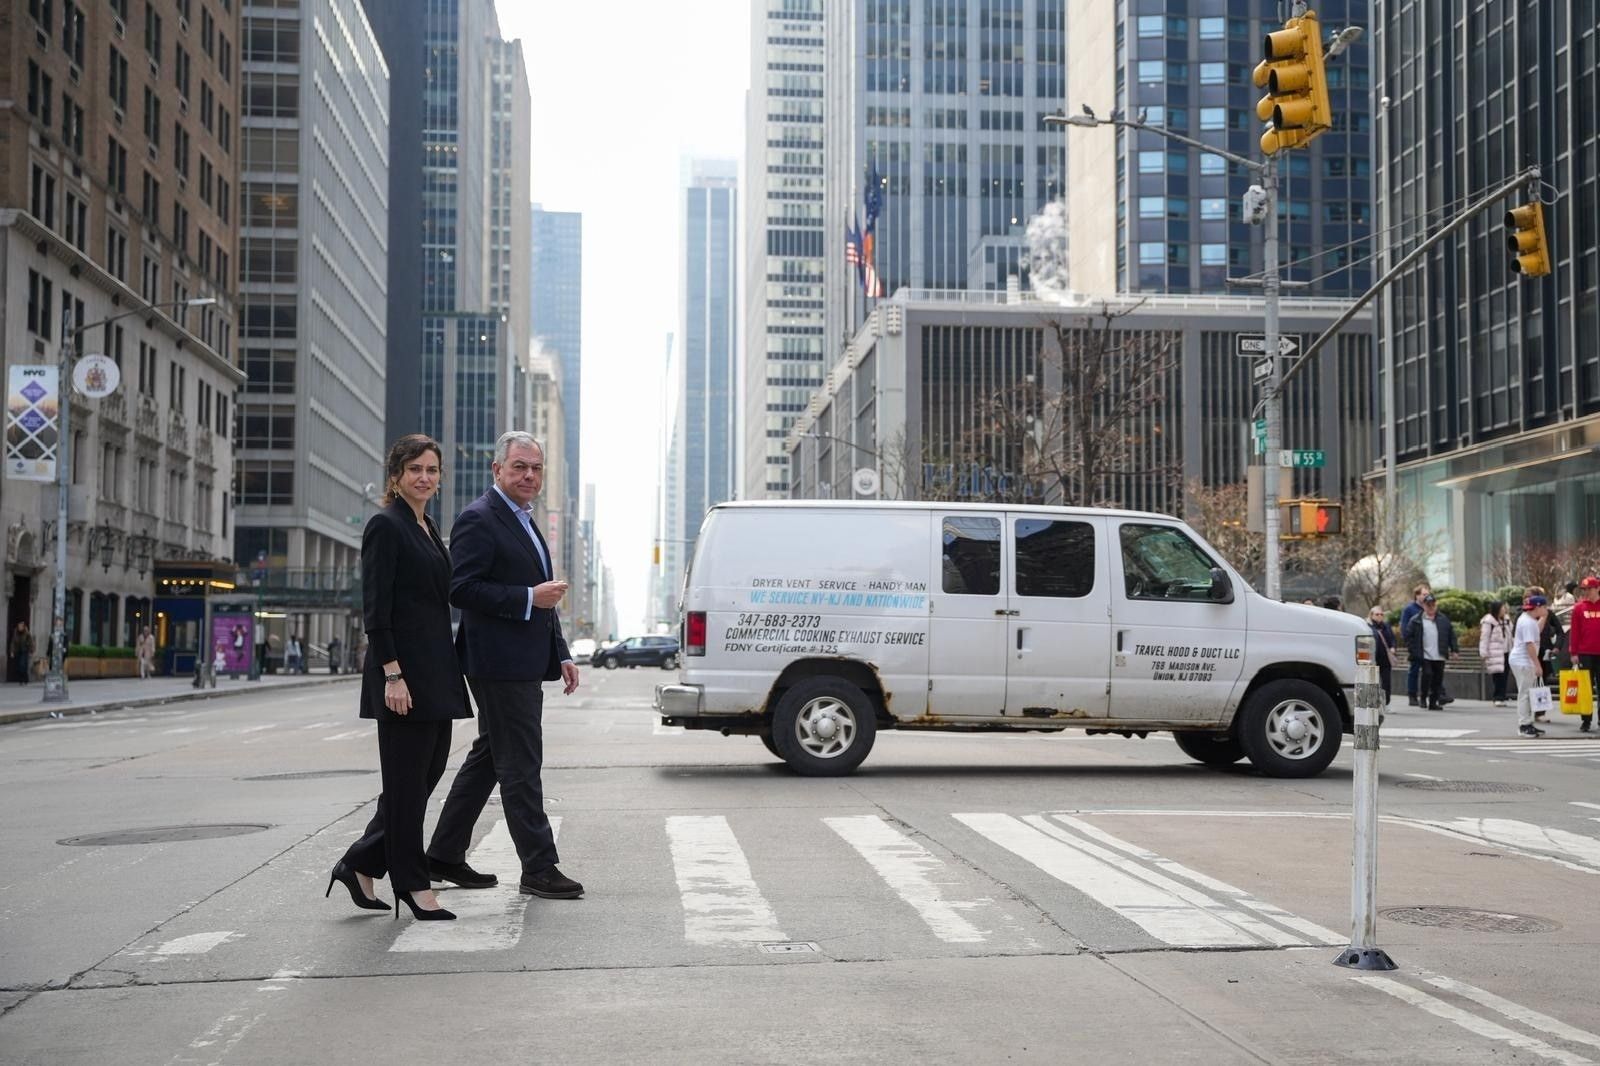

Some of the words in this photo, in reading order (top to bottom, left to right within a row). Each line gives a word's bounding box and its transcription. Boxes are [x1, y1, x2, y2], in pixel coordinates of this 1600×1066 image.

[1243, 341, 1262, 349] ONE
[1293, 452, 1301, 465] W
[1303, 452, 1315, 465] 55
[752, 578, 783, 588] DRYER
[786, 579, 811, 588] VENT
[818, 580, 857, 590] SERVICE
[868, 581, 902, 591] HANDY
[904, 582, 927, 591] MAN
[751, 590, 765, 603] WE
[768, 591, 808, 605] SERVICE
[811, 592, 841, 606] NY-NJ
[842, 593, 863, 606] AND
[865, 594, 925, 609] NATIONWIDE
[737, 613, 821, 628] 347-683-2373
[725, 627, 790, 641] COMMERCIAL
[793, 629, 836, 643] COOKING
[838, 630, 883, 644] EXHAUST
[884, 631, 926, 646] SERVICE
[724, 643, 753, 652] FDNY
[755, 643, 807, 654] Certificate
[819, 645, 838, 654] 125
[1135, 644, 1165, 656] TRAVEL
[1167, 646, 1190, 658] HOOD
[1192, 647, 1199, 658] &
[1200, 647, 1223, 659] DUCT
[1224, 648, 1240, 659] LLC
[1168, 661, 1200, 671] MADISON
[1177, 672, 1188, 681] NJ
[1188, 672, 1213, 682] 07083
